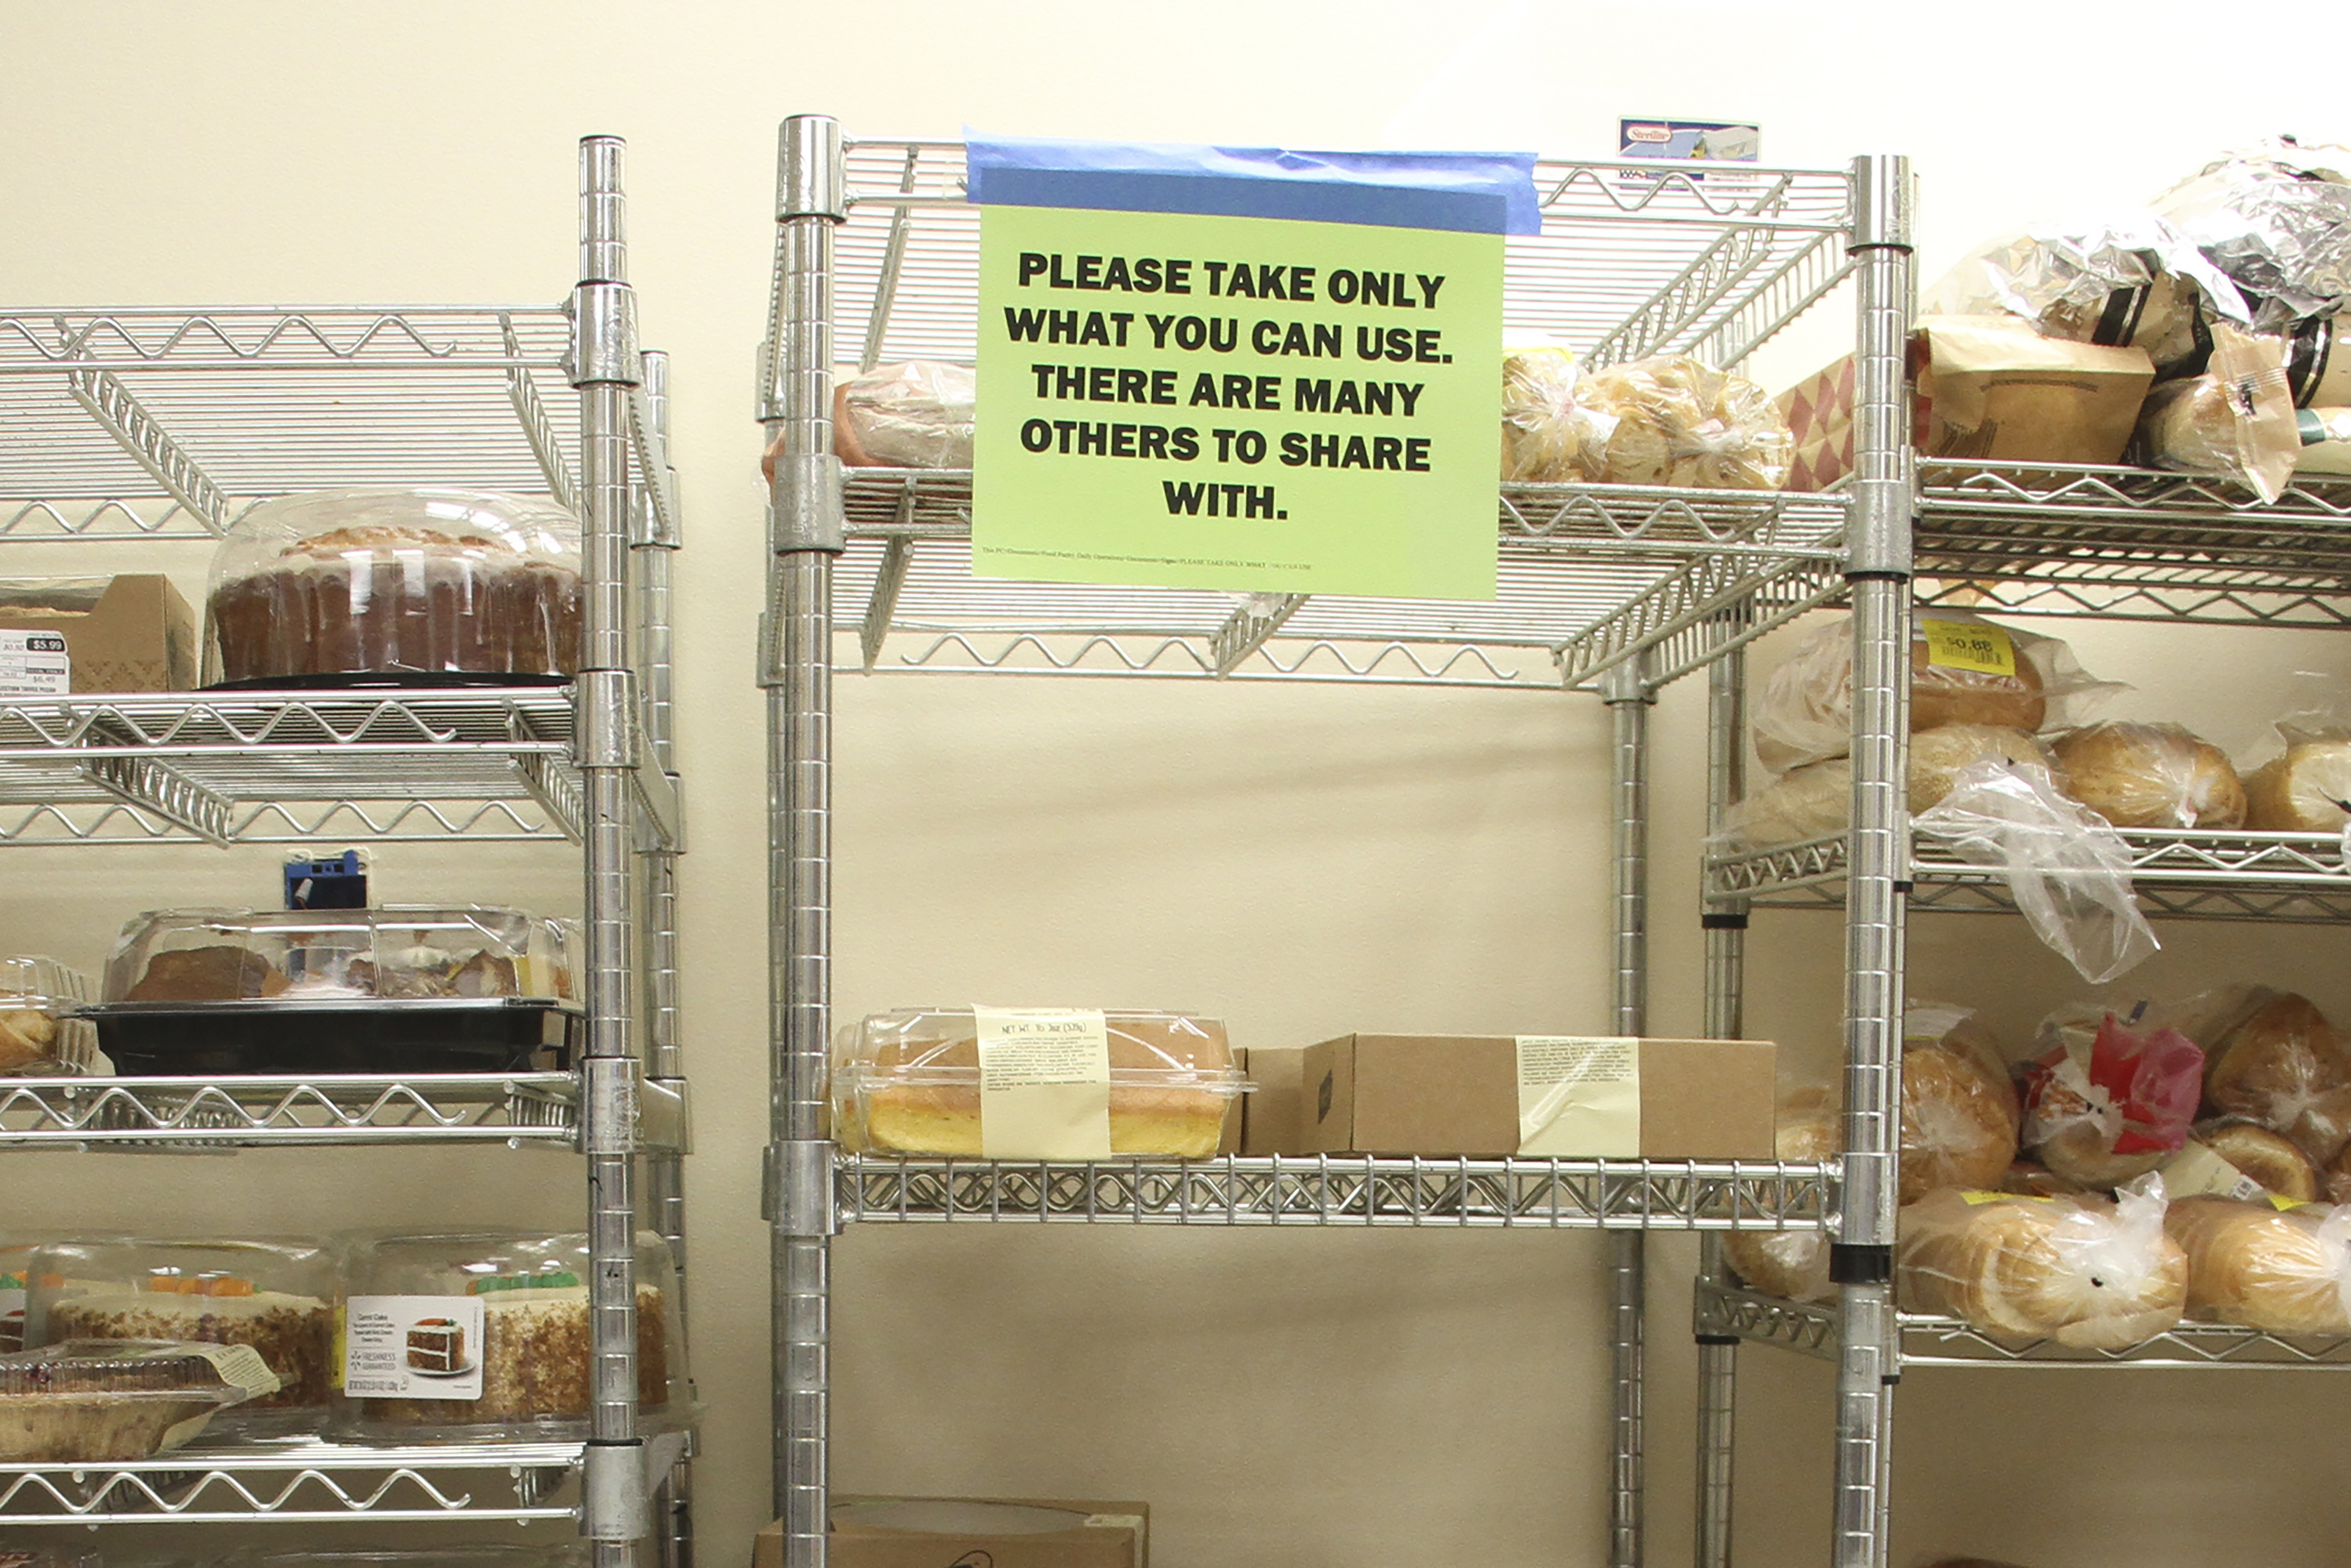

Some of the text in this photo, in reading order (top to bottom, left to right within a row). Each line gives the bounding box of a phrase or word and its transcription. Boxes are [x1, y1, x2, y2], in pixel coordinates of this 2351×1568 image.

[1019, 253, 1445, 308] PLEASE TAKE ONLY
[1004, 307, 1452, 364] WHAT YOU CAN USE.
[1032, 364, 1424, 416] THERE ARE MANY
[1021, 418, 1431, 472] OTHERS TO SHARE
[1163, 481, 1287, 520] WITH.
[34, 640, 62, 650] $5.99
